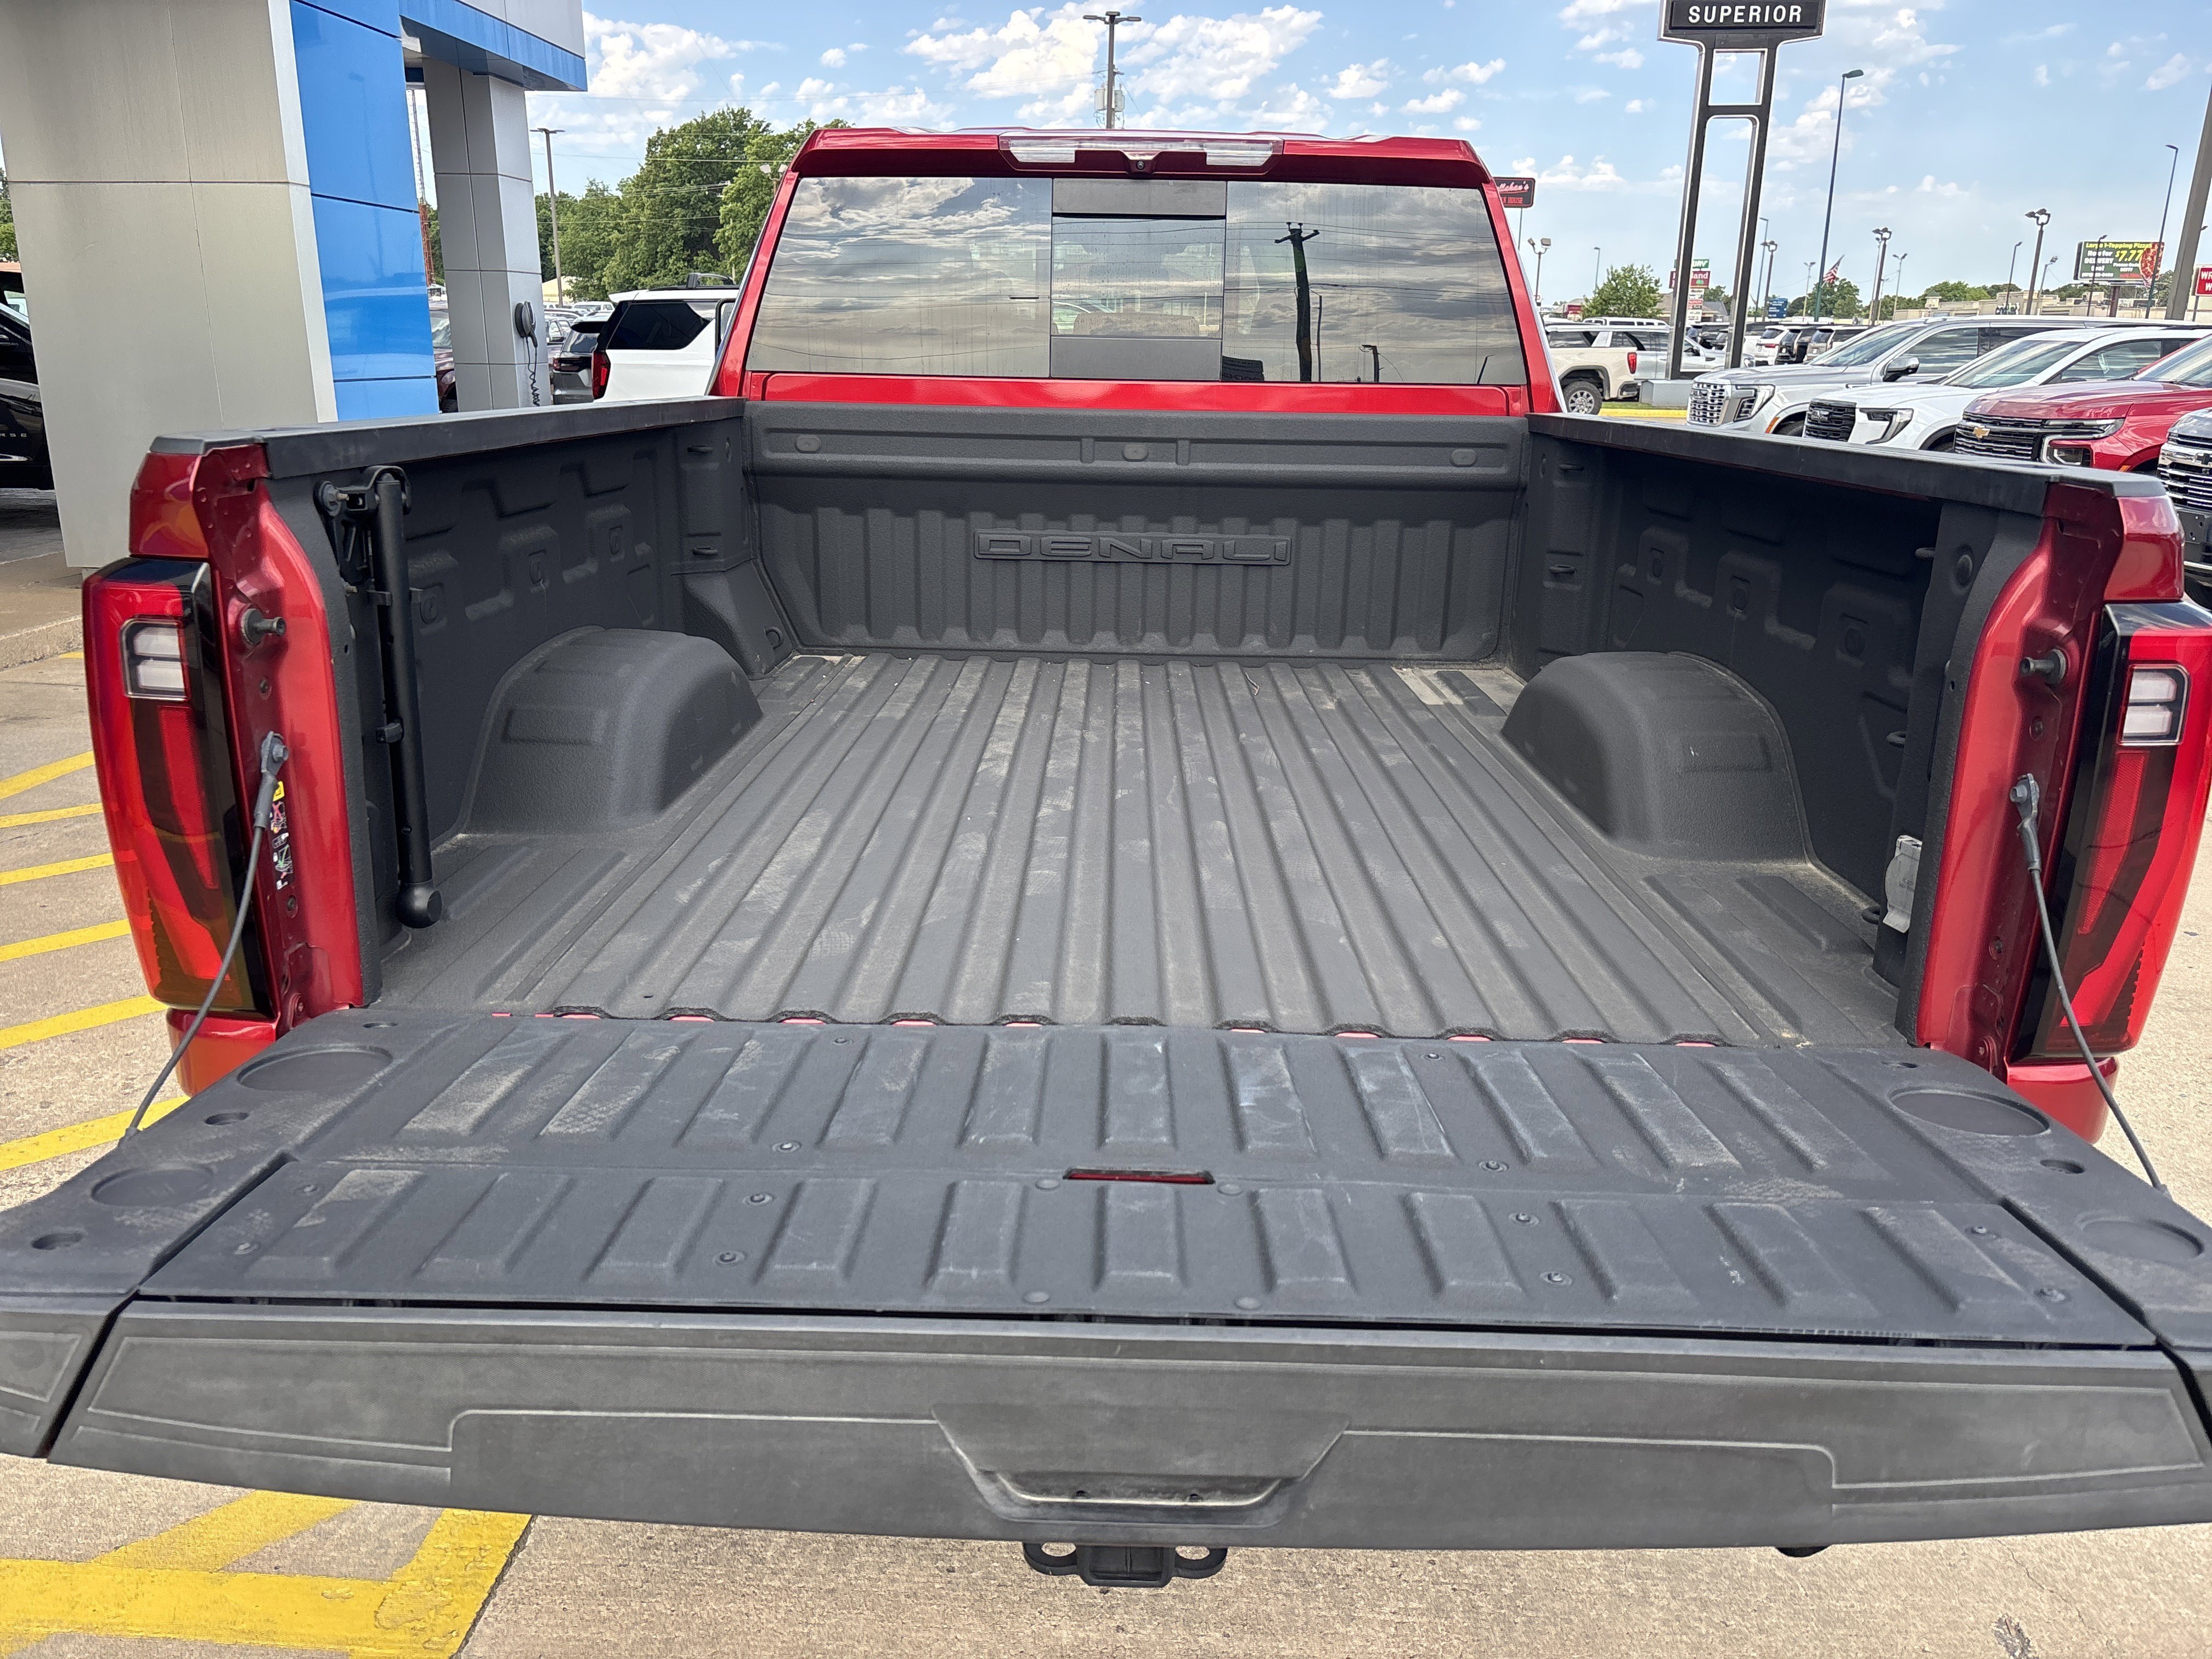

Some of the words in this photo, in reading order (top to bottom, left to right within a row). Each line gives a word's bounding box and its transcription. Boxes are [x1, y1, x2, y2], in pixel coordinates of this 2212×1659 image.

[1688, 5, 1802, 24] SUPERIOR
[2115, 250, 2144, 262] $7.77
[978, 534, 1288, 562] DENALI
